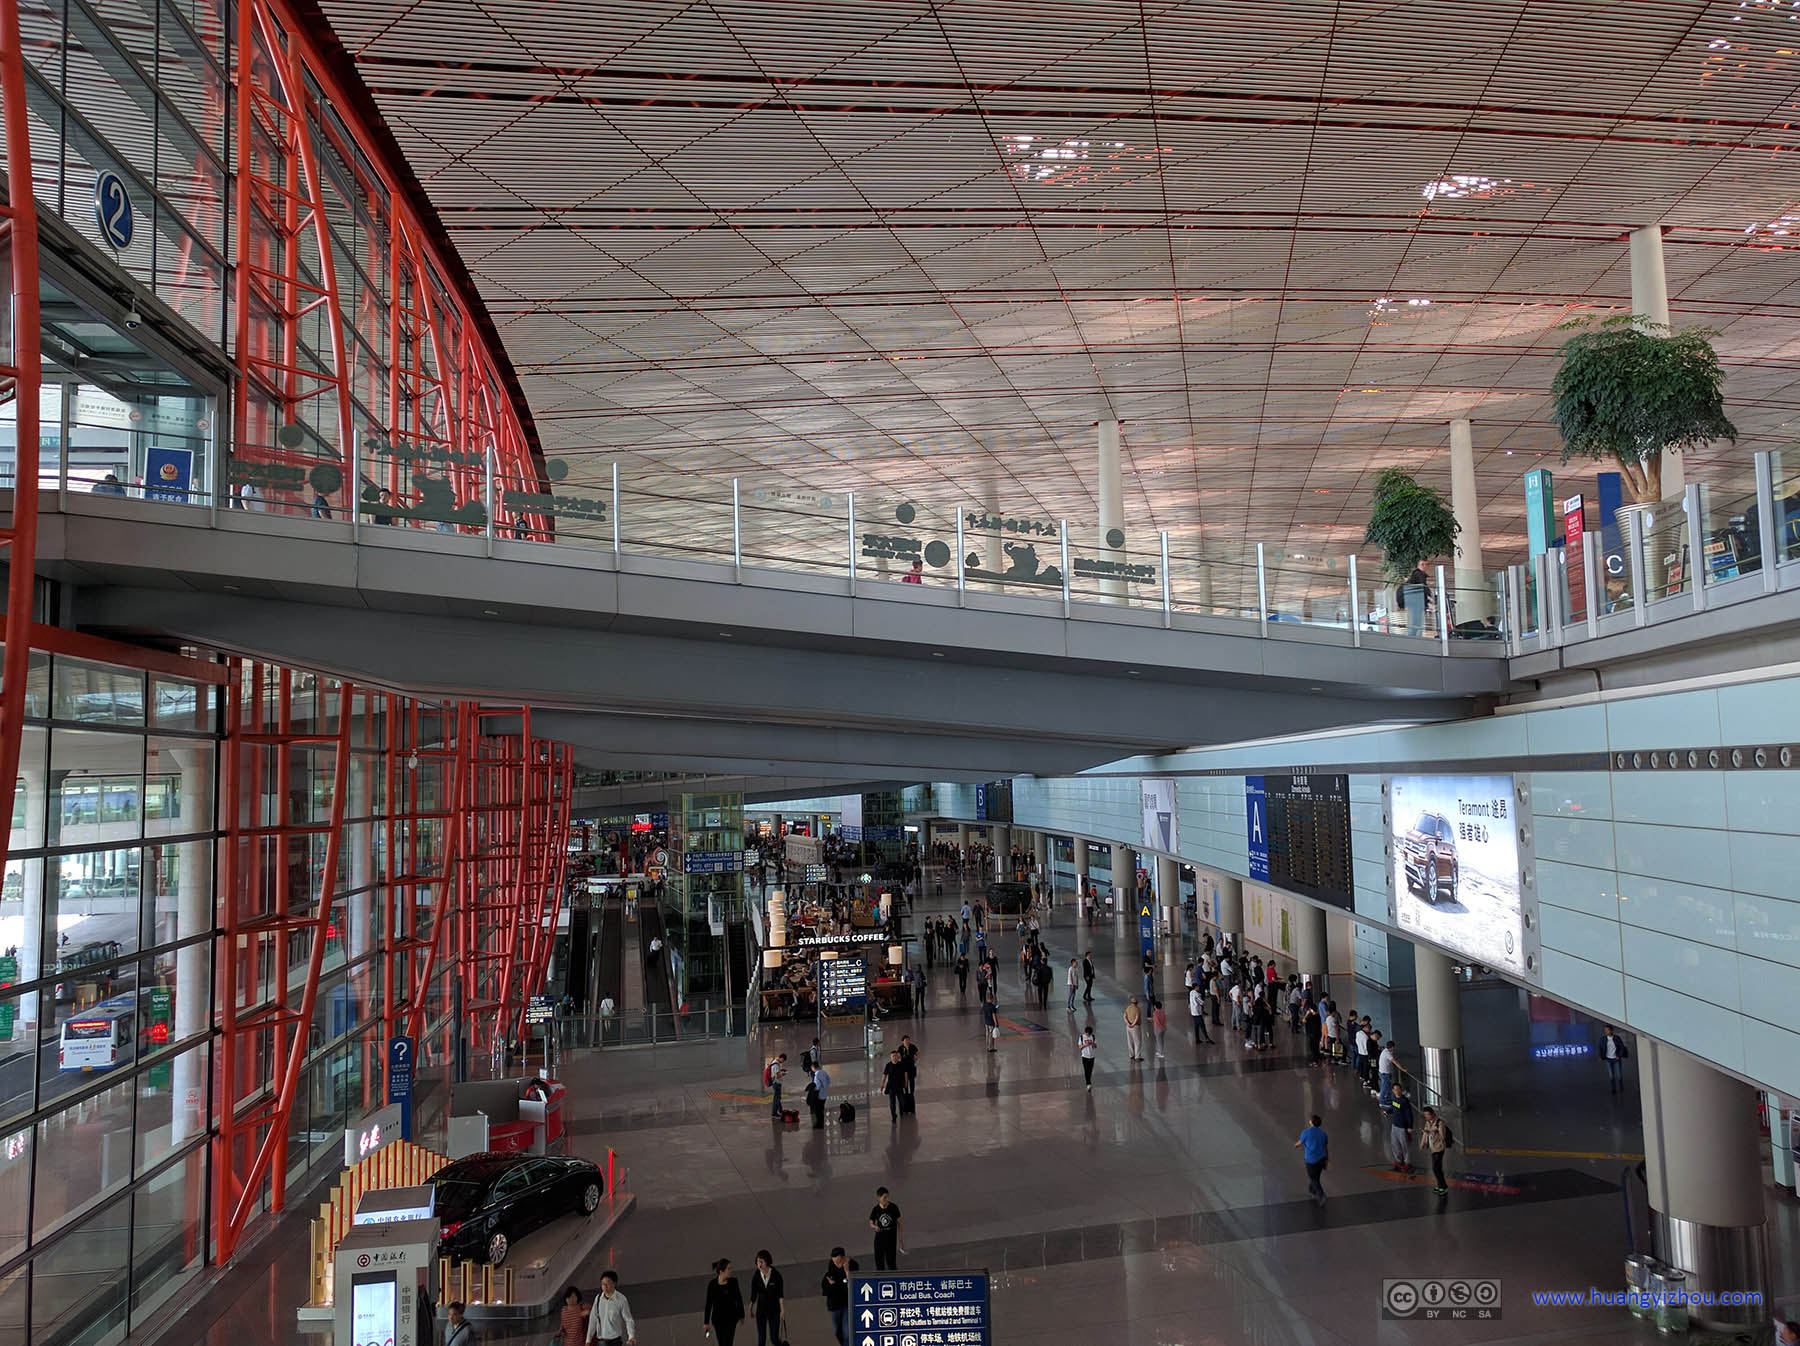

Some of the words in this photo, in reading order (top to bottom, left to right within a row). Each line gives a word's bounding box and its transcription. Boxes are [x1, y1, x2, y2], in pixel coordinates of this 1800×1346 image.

[109, 181, 126, 243] 2
[1606, 554, 1623, 574] C
[1458, 799, 1490, 817] Teramont
[1252, 801, 1263, 844] A
[1141, 905, 1151, 917] A
[798, 935, 851, 946] STARBUCKS
[851, 933, 885, 943] COFFEE
[855, 959, 862, 967] C
[899, 1280, 973, 1291] 市内巴士、省际巴士
[899, 1292, 917, 1300] Local
[918, 1291, 933, 1300] Bus,
[934, 1291, 955, 1299] Coach
[401, 1286, 411, 1324] 中国银行
[910, 1319, 927, 1327] Shuttles
[932, 1318, 949, 1326] Terminal
[962, 1317, 978, 1325] Terminal
[920, 1332, 982, 1344] 停车场、地铁机场线
